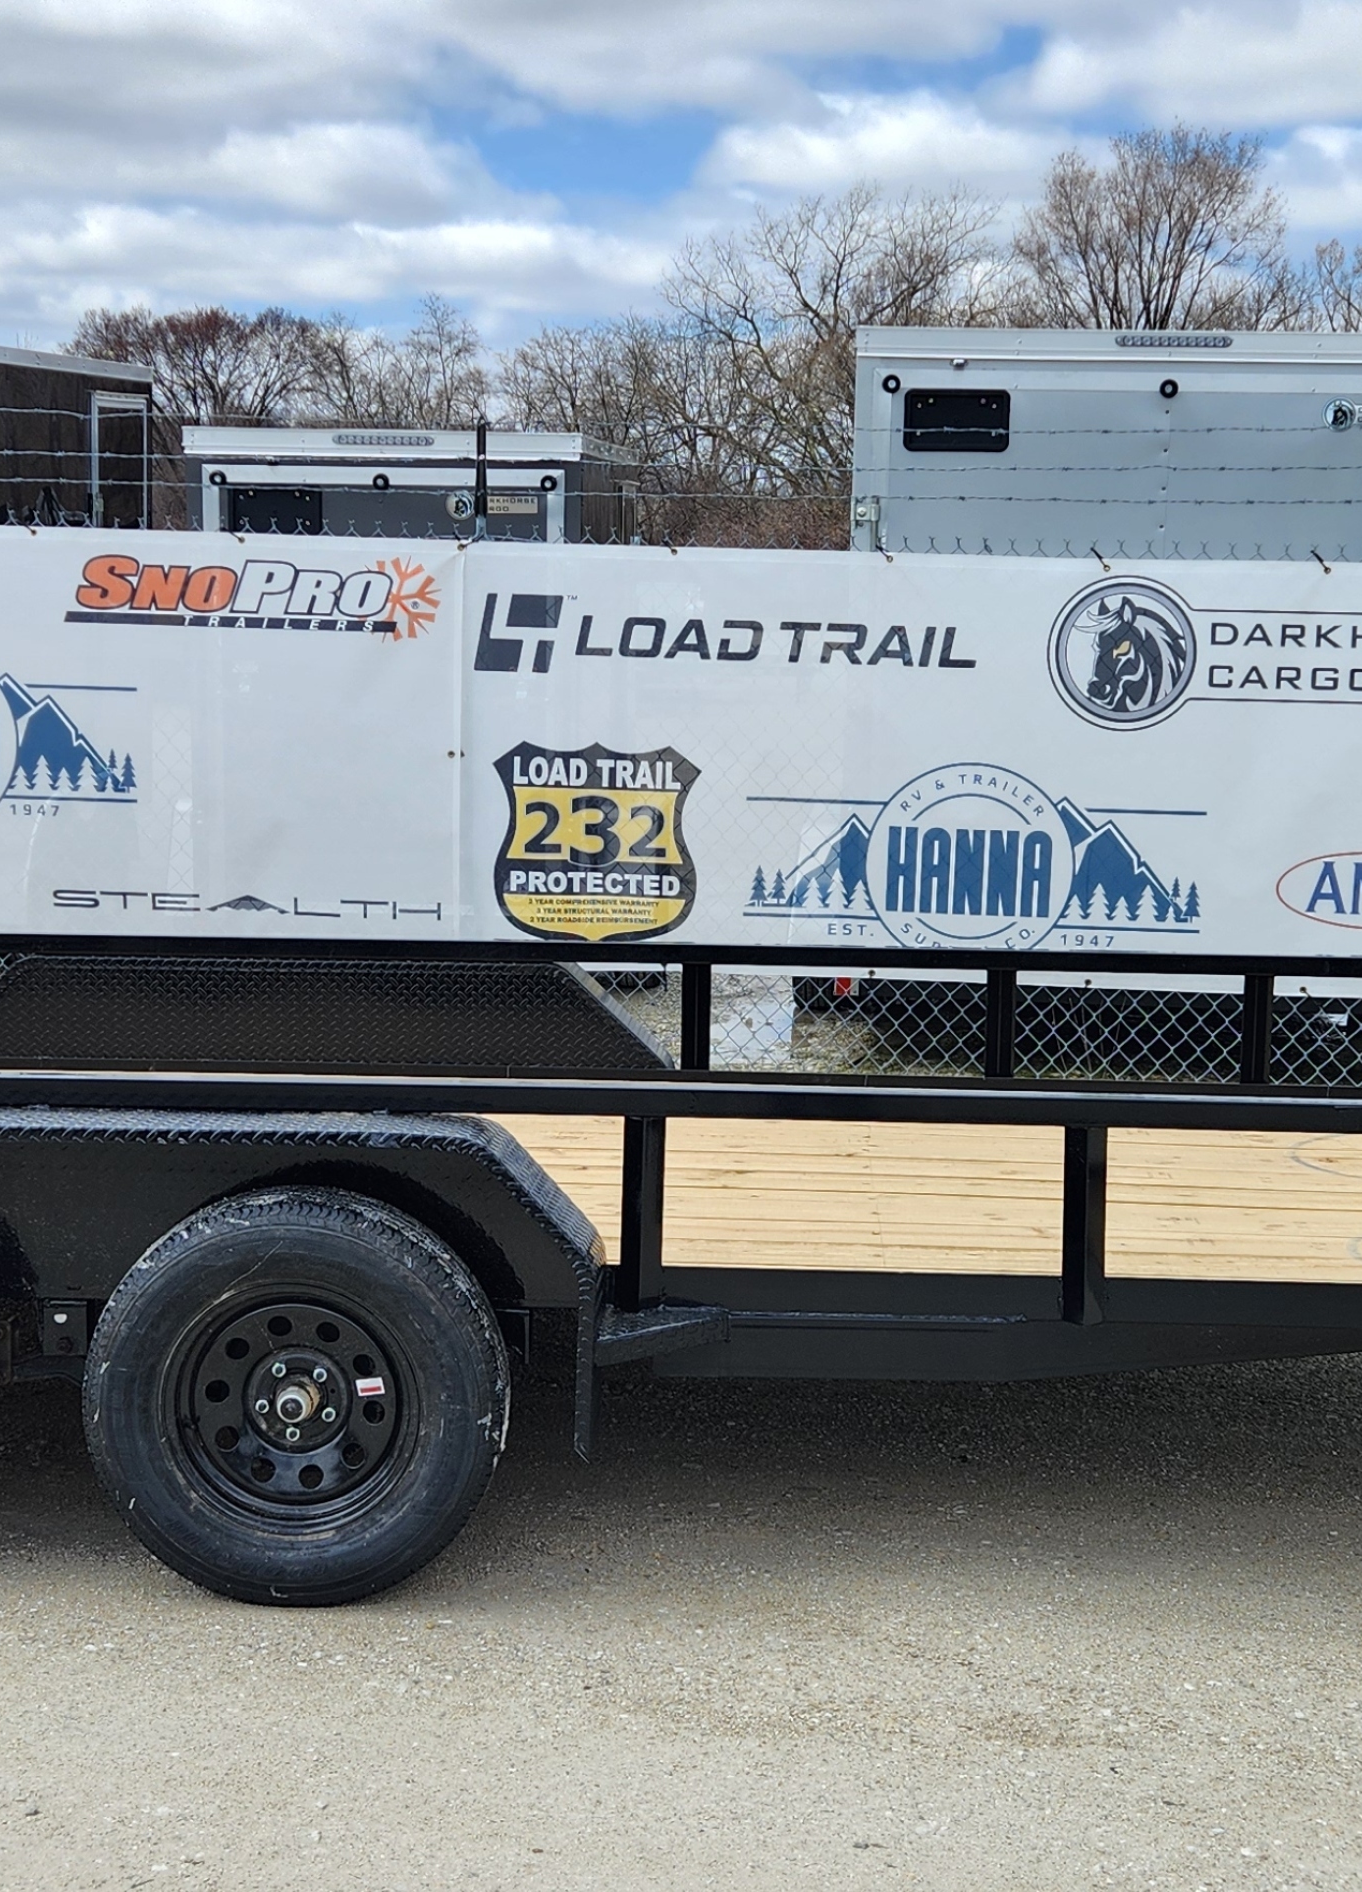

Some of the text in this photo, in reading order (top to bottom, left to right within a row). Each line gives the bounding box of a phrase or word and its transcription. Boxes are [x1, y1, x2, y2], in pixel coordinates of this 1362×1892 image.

[183, 614, 375, 633] TRAILERS
[575, 615, 977, 668] LOAD TRAIL
[513, 755, 682, 790] LOAD TRAIL
[9, 803, 60, 817] 1947
[900, 773, 1045, 817] RV & TRAILER
[523, 794, 667, 867] 232
[509, 870, 681, 897] PROTECTED
[885, 825, 1053, 918] HANNA
[827, 923, 874, 937] EST.
[1060, 933, 1115, 948] 1947
